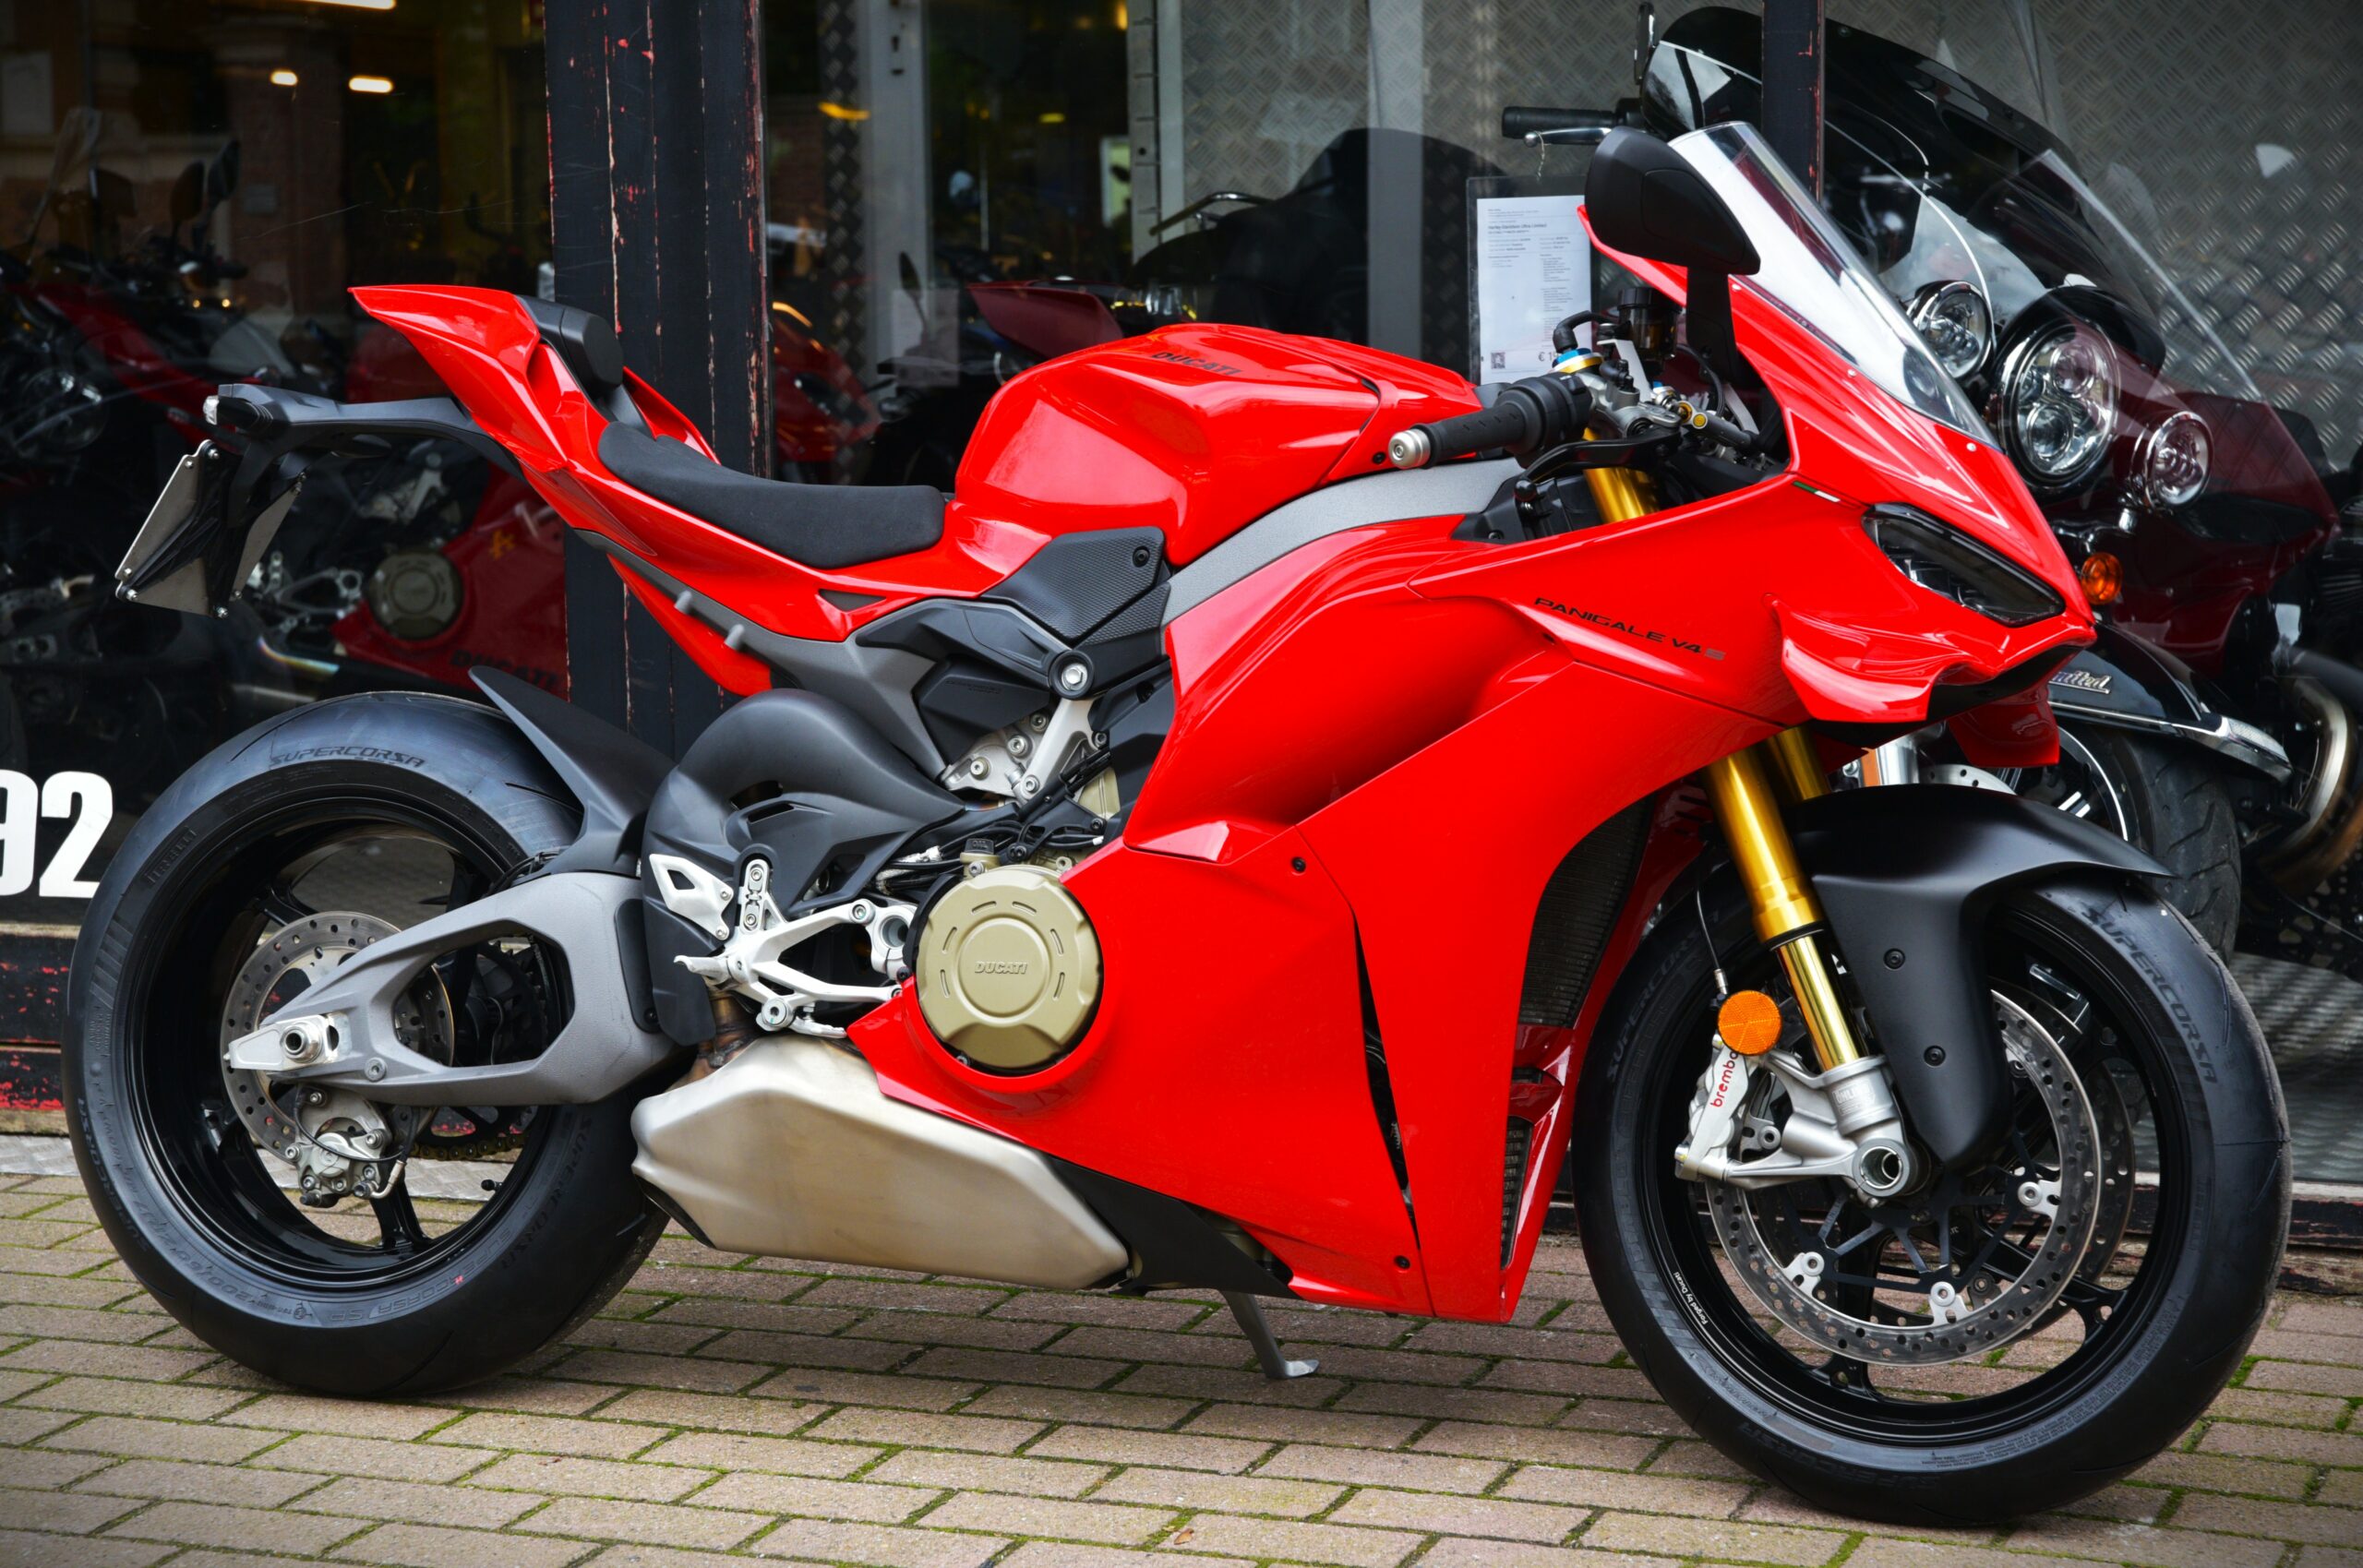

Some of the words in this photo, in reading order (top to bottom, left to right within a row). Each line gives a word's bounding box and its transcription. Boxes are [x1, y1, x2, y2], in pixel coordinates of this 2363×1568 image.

[1151, 352, 1241, 376] DUCATI
[1534, 597, 1665, 642] PANIGALE
[269, 746, 426, 768] SUPERCORSA
[0, 769, 114, 898] 92
[975, 961, 1027, 975] DUCATI
[2081, 902, 2217, 1084] SUPERCORSA
[1709, 1051, 1739, 1107] brembo
[1673, 1272, 1688, 1294] Ducati
[1685, 1294, 1694, 1302] by
[1690, 1302, 1709, 1325] Forged
